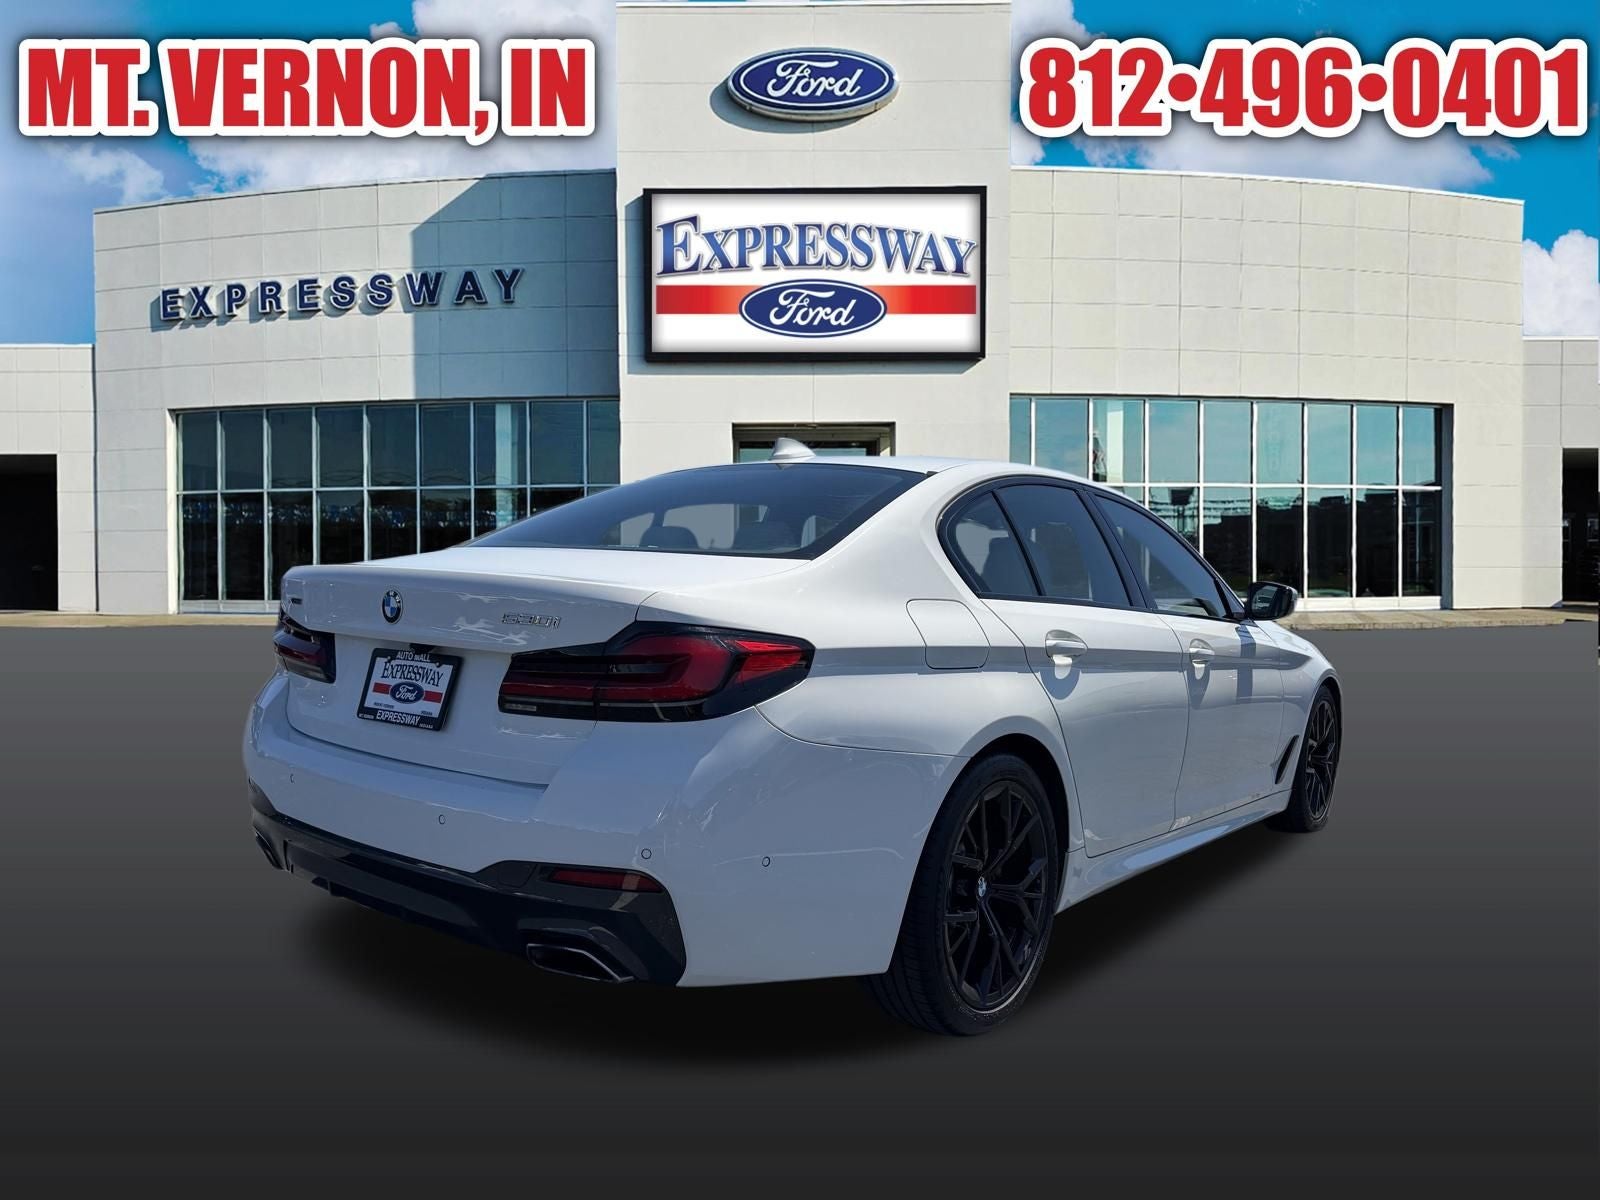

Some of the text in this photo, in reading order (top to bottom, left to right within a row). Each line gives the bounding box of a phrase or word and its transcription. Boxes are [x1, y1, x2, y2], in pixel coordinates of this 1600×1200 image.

[766, 59, 863, 97] Ford
[655, 214, 978, 277] EXPRESSWAY
[159, 267, 524, 320] EXPRESSWAY
[769, 288, 857, 326] Ford
[396, 651, 431, 662] AUTO MALL
[381, 661, 444, 687] EXPRESSWAY
[395, 684, 418, 701] Ford
[376, 710, 421, 726] EXPRESSWAY
